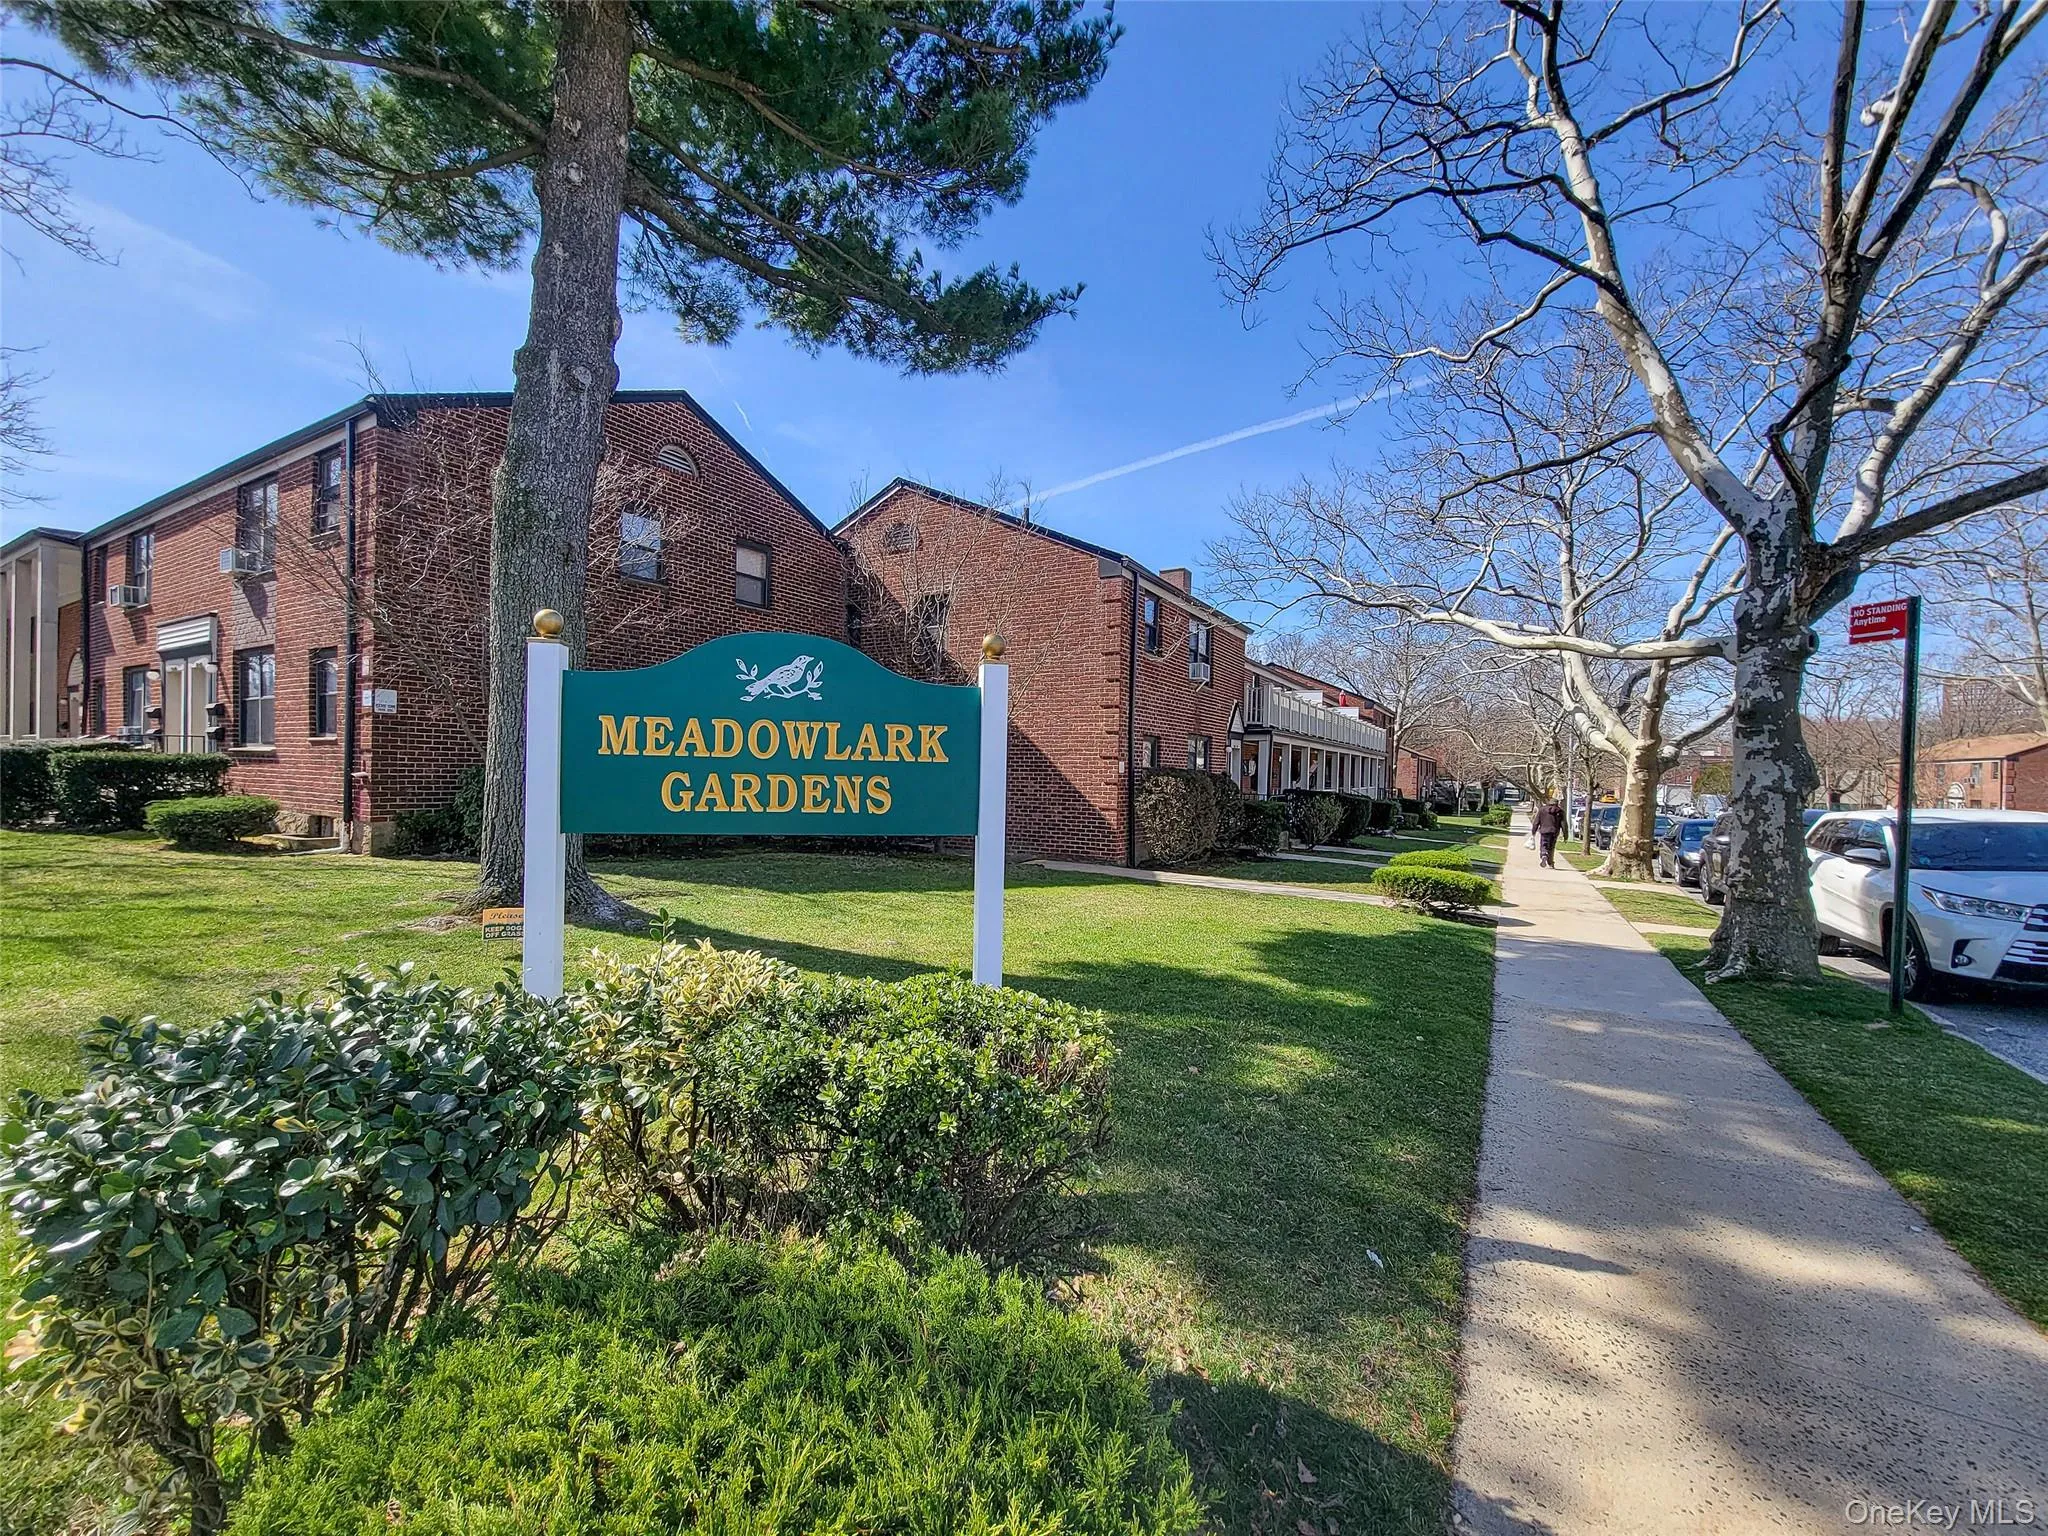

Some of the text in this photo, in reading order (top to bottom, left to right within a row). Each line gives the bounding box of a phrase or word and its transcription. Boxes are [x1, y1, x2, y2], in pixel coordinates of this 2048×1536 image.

[1853, 603, 1907, 617] NO STANDING
[1853, 616, 1886, 627] Anytime
[598, 715, 949, 763] MEADOWLARK
[661, 771, 892, 815] GARDENS
